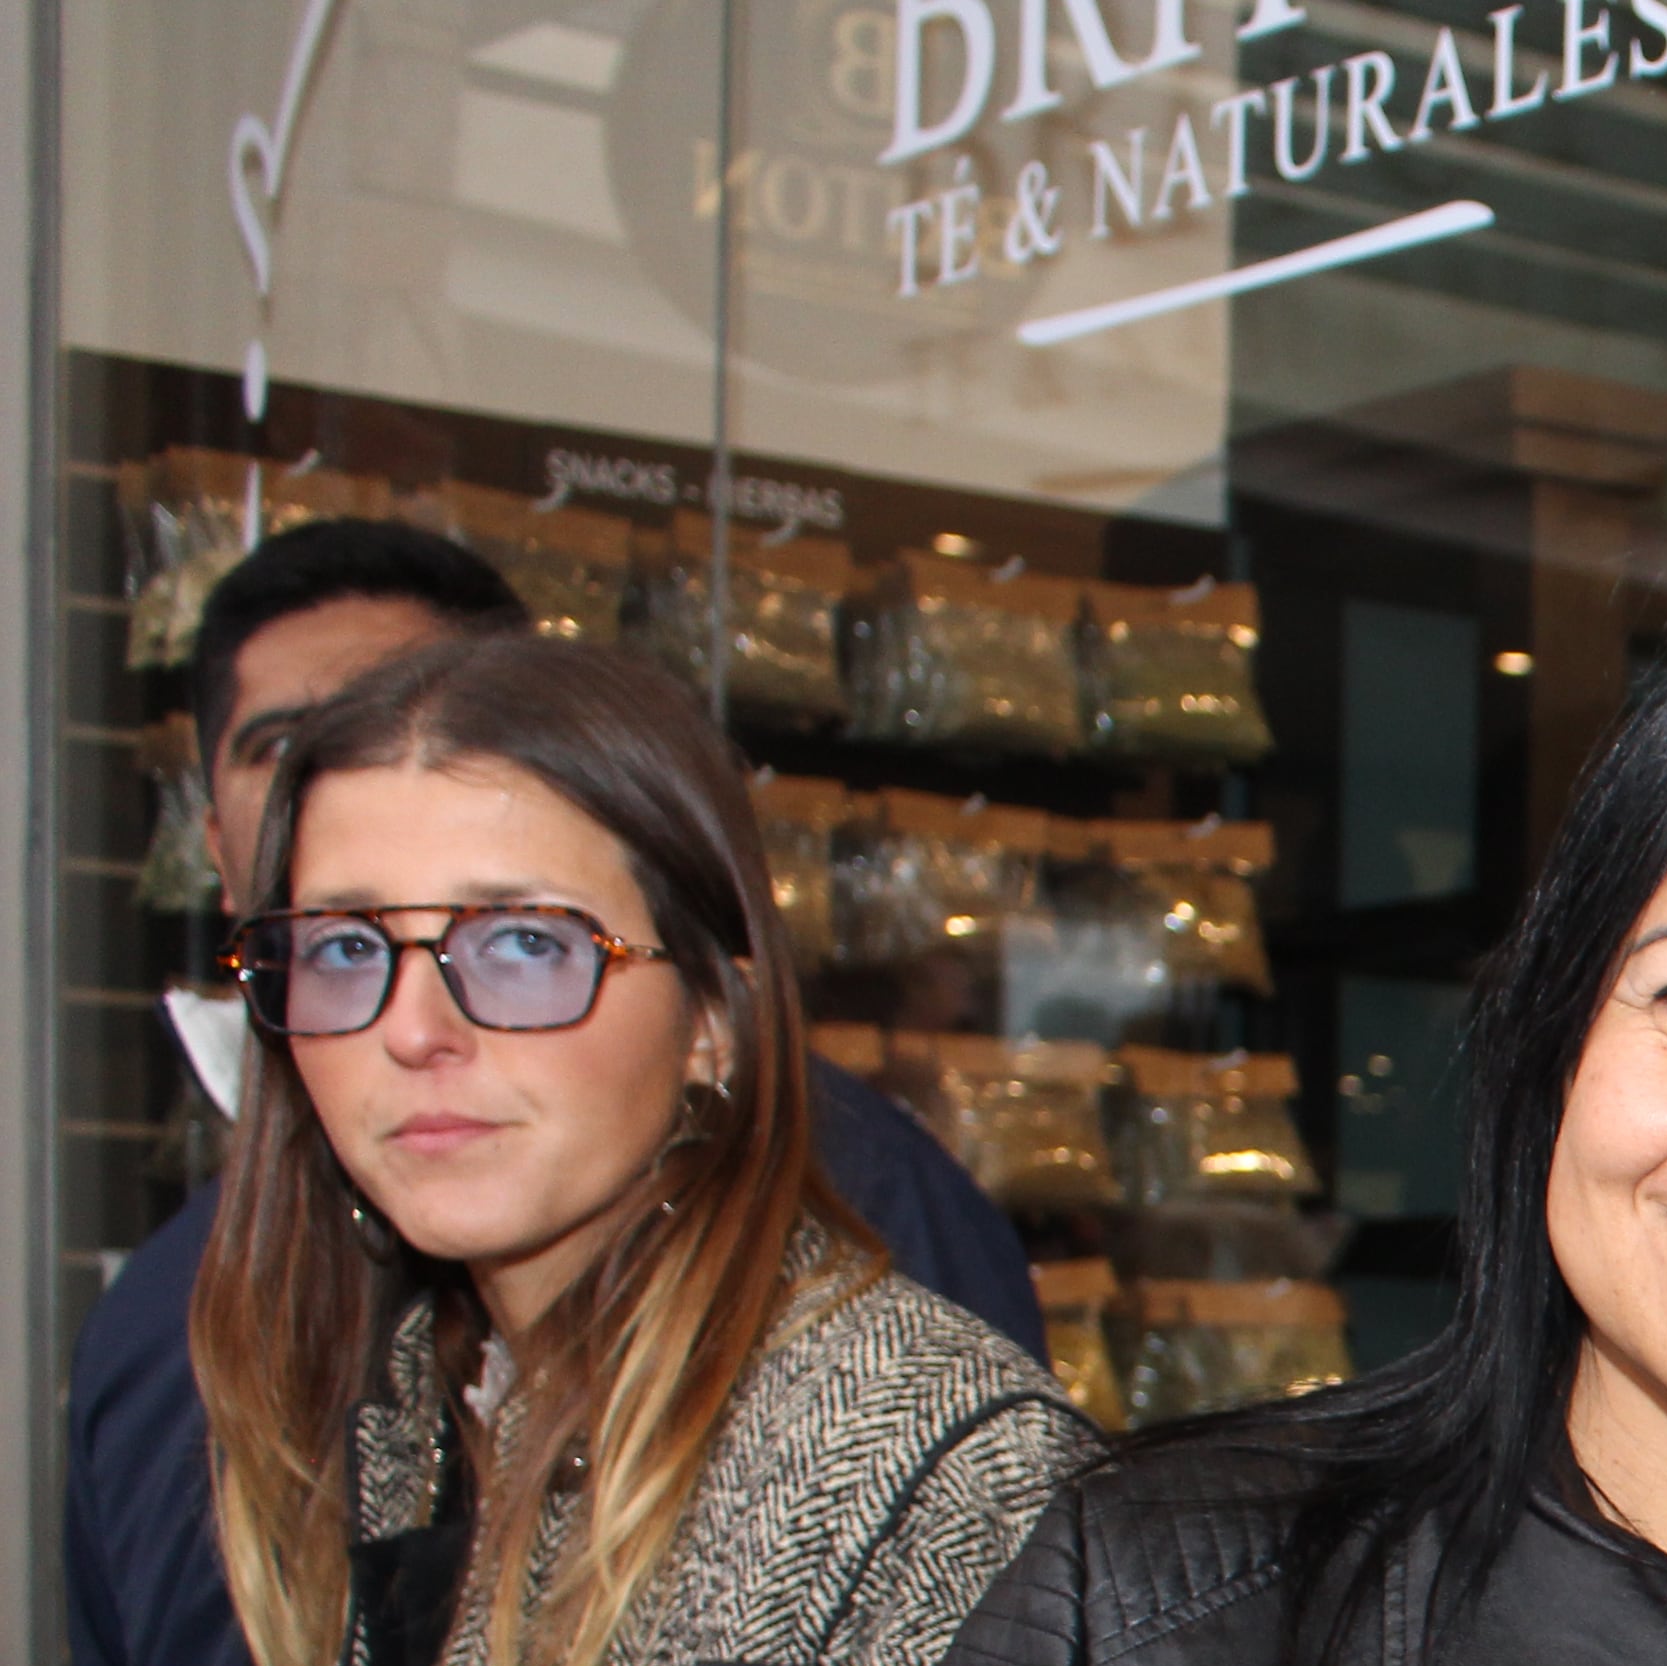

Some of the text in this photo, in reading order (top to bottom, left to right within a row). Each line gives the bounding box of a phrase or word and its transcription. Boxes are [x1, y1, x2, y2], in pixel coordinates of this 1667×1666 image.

[886, 154, 981, 298] TÉ
[1004, 160, 1064, 266] &
[545, 448, 678, 505] SNACKS
[706, 472, 844, 530] ERBAS
